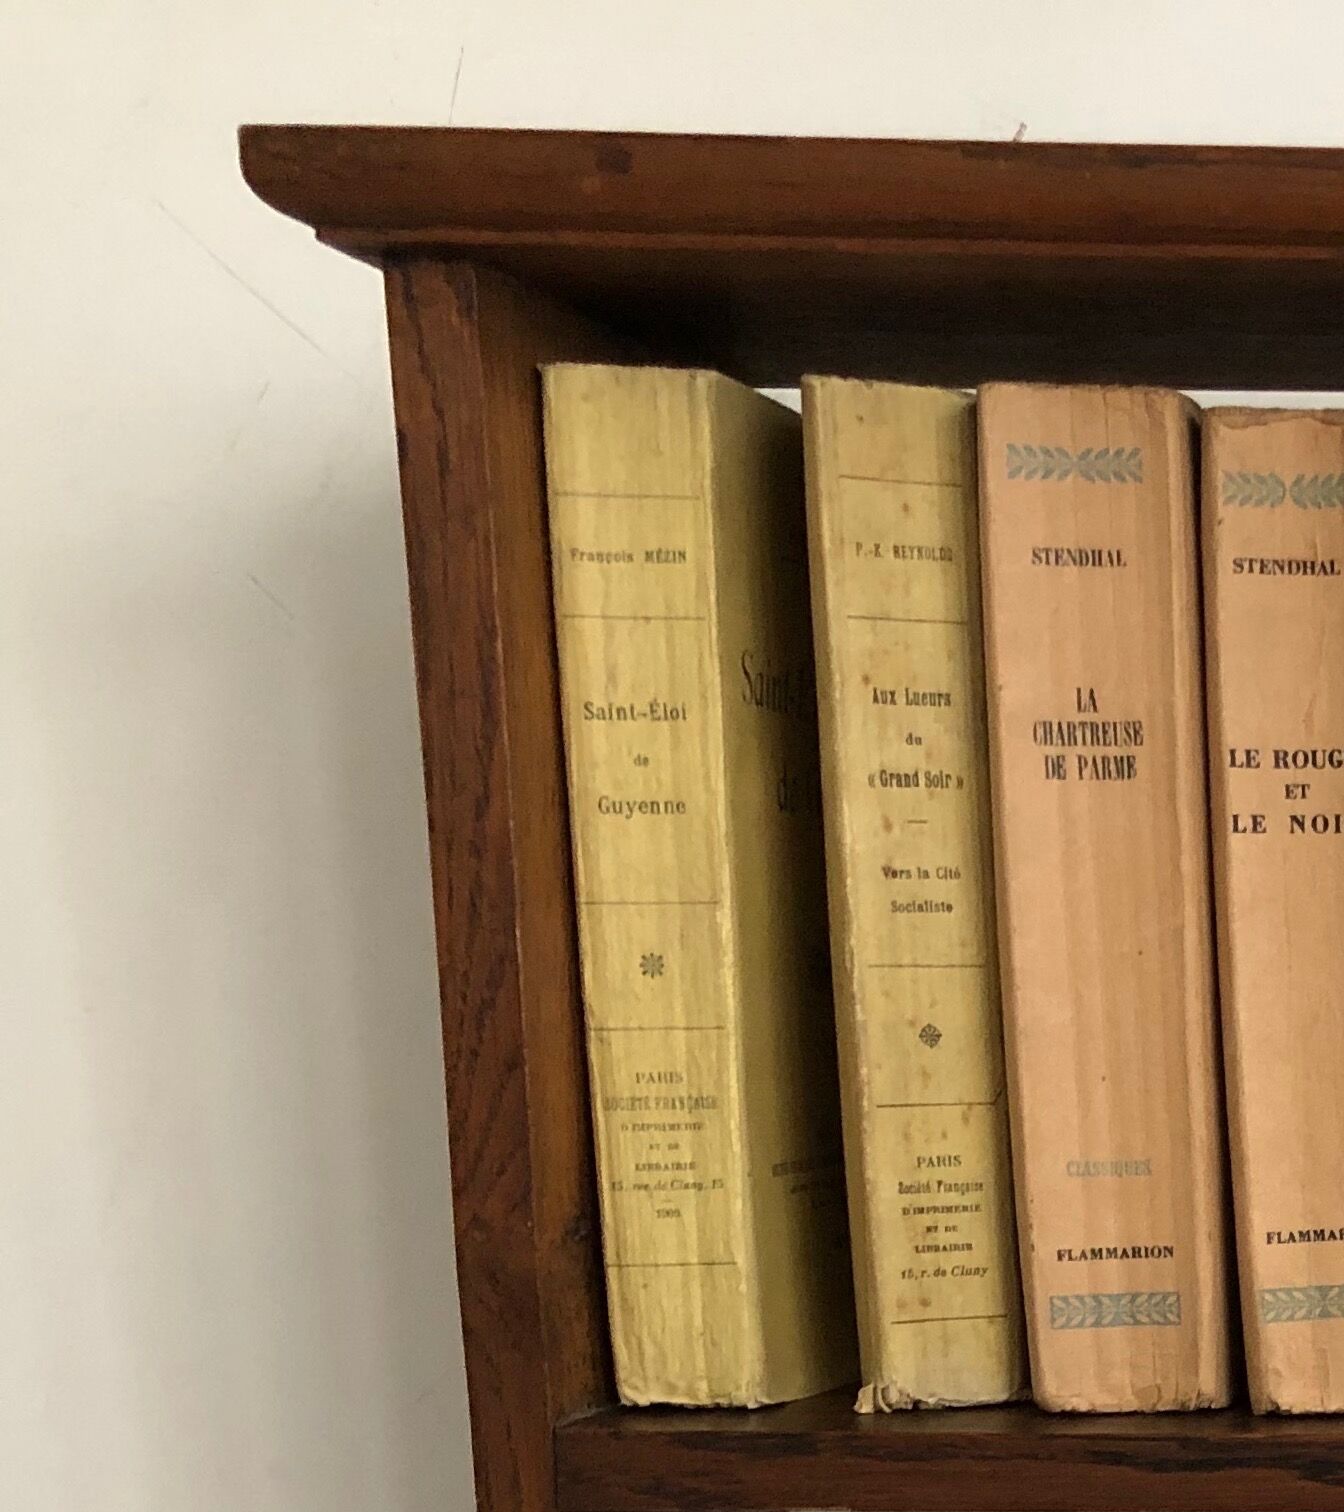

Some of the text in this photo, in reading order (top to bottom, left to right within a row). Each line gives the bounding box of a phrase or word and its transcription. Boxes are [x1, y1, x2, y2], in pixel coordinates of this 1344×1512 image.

[1031, 547, 1127, 568] STENDHAL
[1232, 557, 1341, 577] STENDHAL
[872, 687, 951, 707] Aux Lueurs
[1076, 687, 1098, 714] LA
[583, 698, 687, 722] Saint-Éloi
[906, 733, 922, 746] du
[1033, 720, 1143, 747] CHARTREUSE
[633, 753, 649, 767] de
[1044, 754, 1138, 781] DE PARME
[1228, 748, 1261, 769] LE
[880, 769, 919, 788] Grand
[924, 771, 952, 789] Soir
[1284, 783, 1311, 800] ET
[598, 796, 686, 819] Guyenne
[1232, 814, 1267, 835] LE
[881, 866, 961, 880] Vers la Cité
[891, 900, 954, 914] Socialiste
[636, 1071, 684, 1084] PARIS
[917, 1154, 962, 1168] PARIS
[1056, 1245, 1174, 1262] FLAMMARION
[951, 1264, 989, 1278] Cluny
